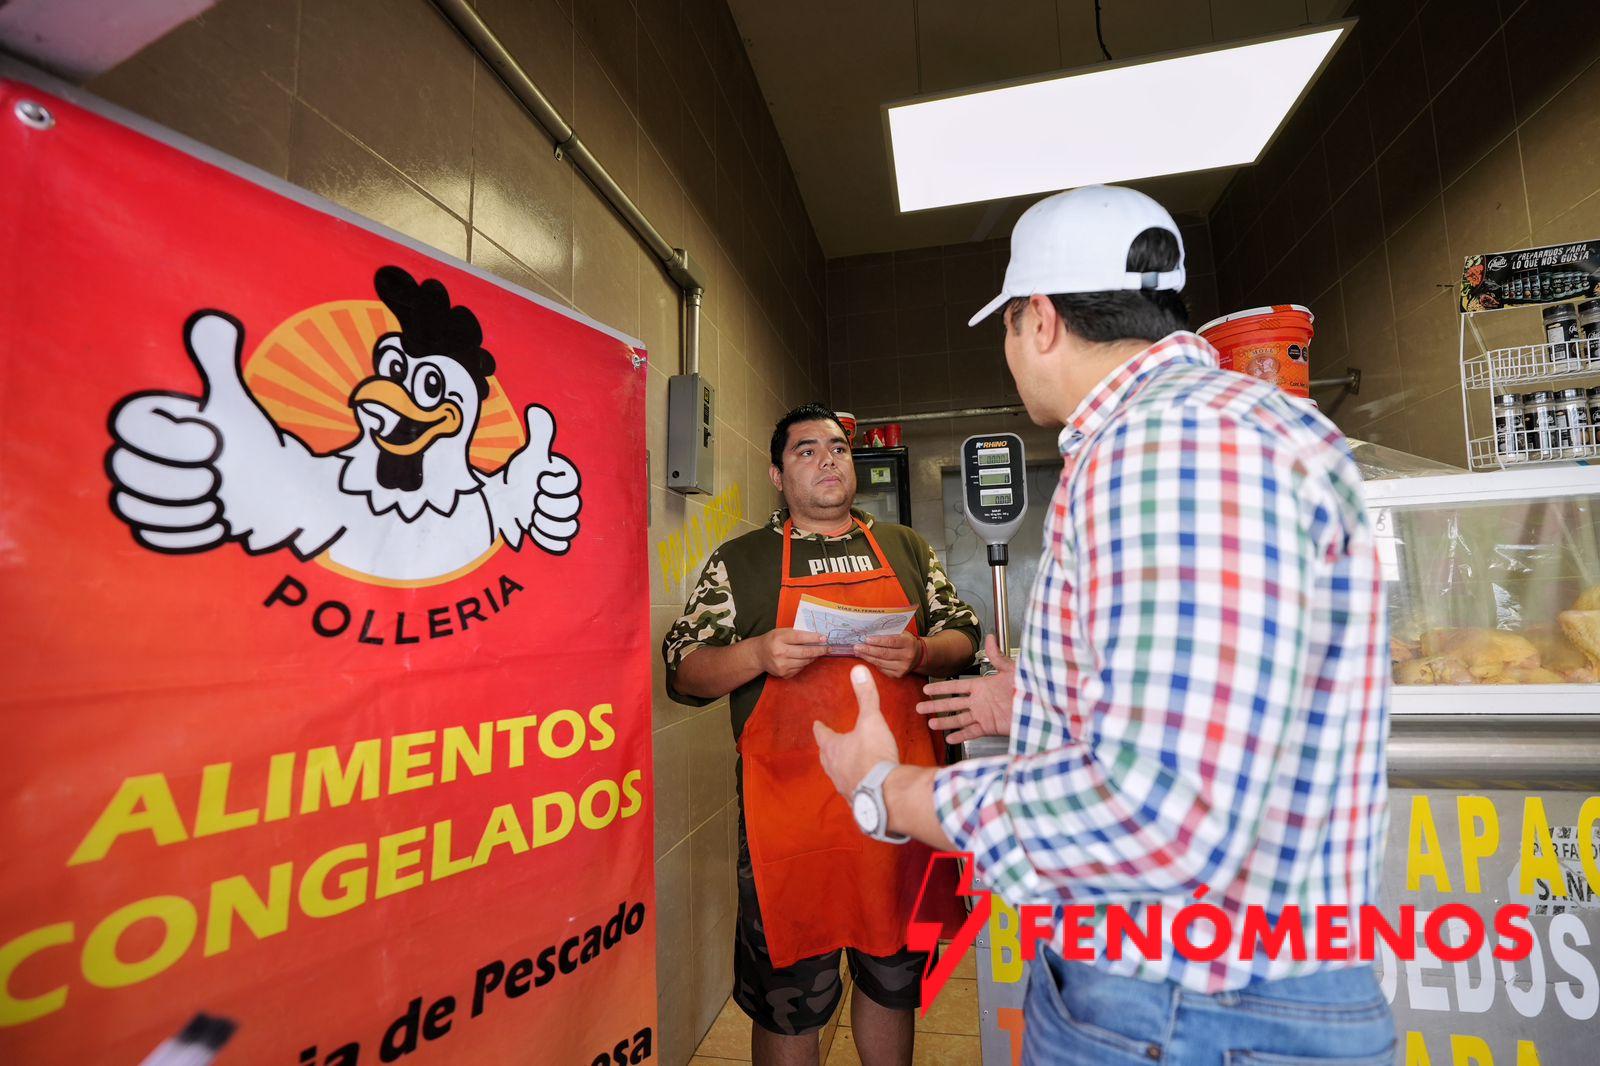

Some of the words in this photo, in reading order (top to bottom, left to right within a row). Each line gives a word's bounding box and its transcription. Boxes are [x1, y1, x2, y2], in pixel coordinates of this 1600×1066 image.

[1512, 260, 1522, 270] LO
[1524, 258, 1539, 269] QUE
[1541, 256, 1558, 266] NOS
[1561, 250, 1590, 263] GUSTA
[808, 555, 874, 576] PUMA
[263, 573, 524, 646] POLLERIA
[66, 703, 616, 867] ALIMENTOS
[1533, 842, 1558, 857] PR
[0, 769, 643, 1028] CONGELADOS
[379, 996, 457, 1063] de
[470, 901, 646, 1018] Pescado
